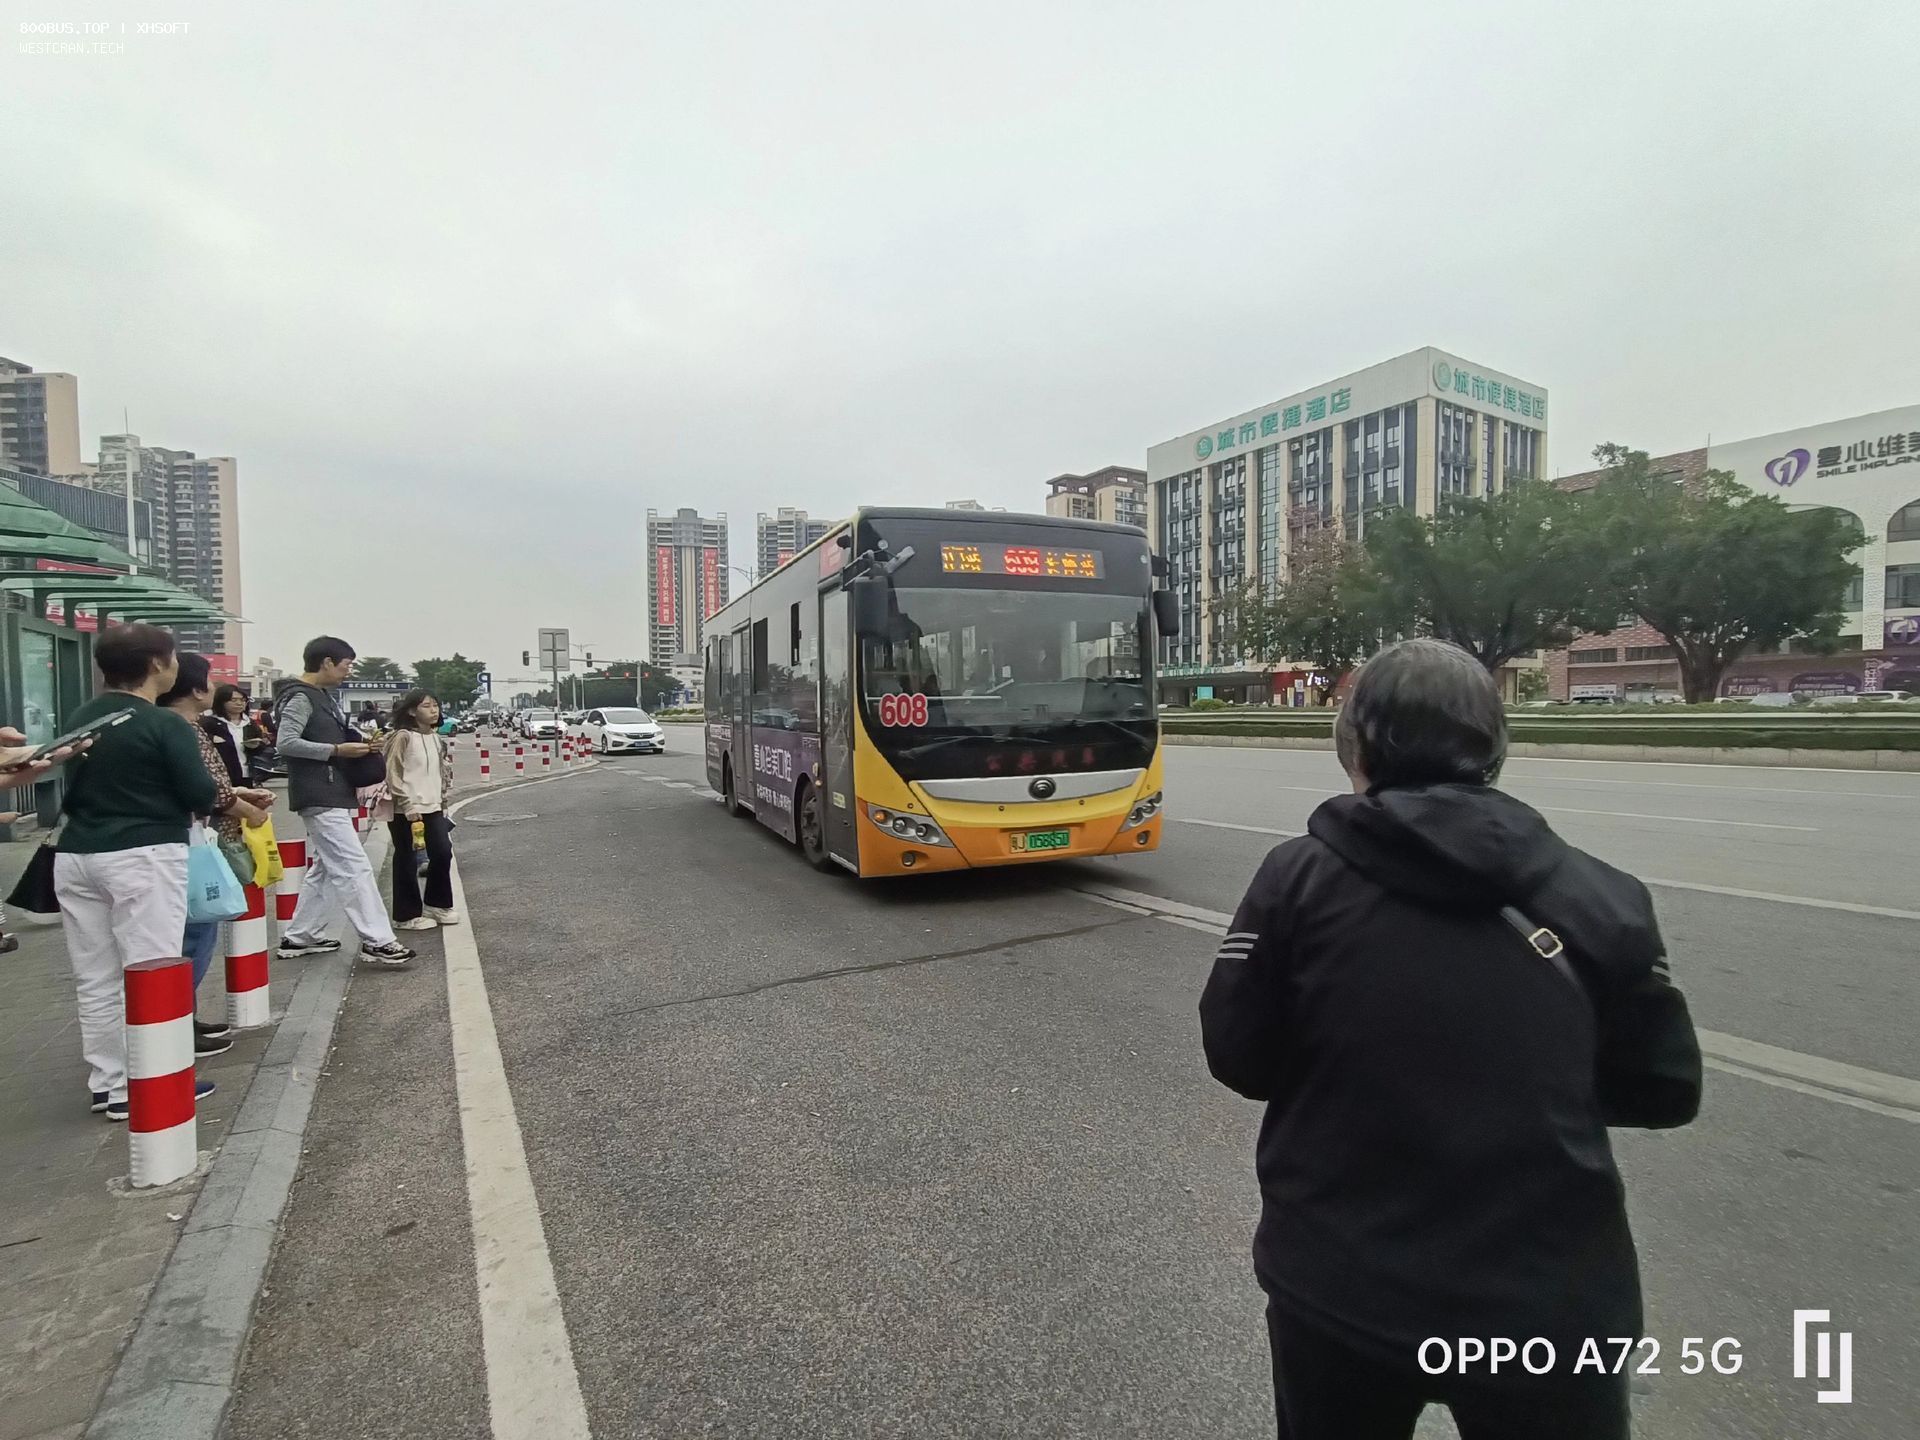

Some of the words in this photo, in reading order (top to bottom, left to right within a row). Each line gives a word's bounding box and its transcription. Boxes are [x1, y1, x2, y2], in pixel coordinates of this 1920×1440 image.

[1454, 367, 1545, 421] 城市便捷酒店
[1217, 386, 1352, 452] 城市便捷酒店
[1816, 464, 1857, 479] SMILE
[879, 693, 929, 727] 608
